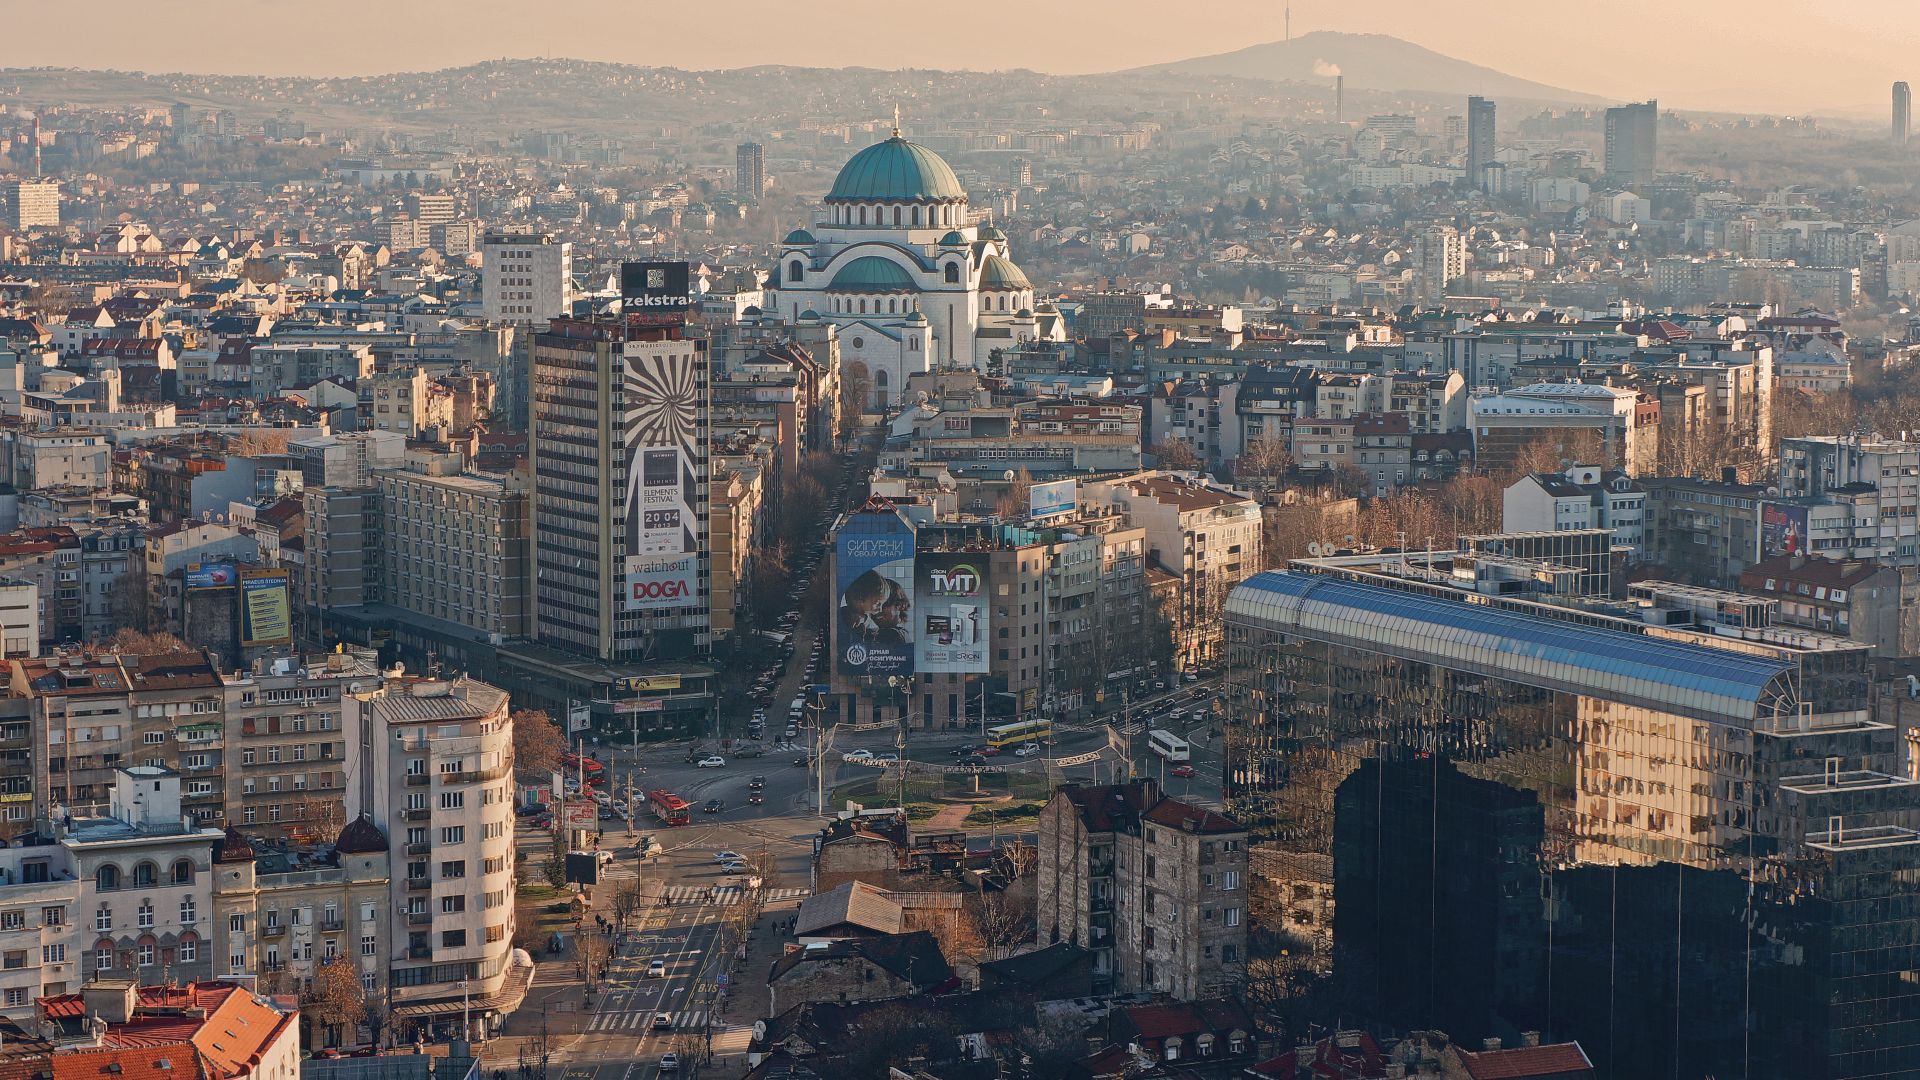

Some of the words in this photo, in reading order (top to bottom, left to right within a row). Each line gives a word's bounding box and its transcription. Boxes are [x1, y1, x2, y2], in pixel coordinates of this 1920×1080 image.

[624, 294, 687, 306] zekstra
[644, 489, 678, 497] ELEMENTS
[644, 496, 674, 504] FESTIVAL
[847, 540, 904, 551] СИГУРНИ
[633, 559, 689, 574] watchout
[646, 918, 667, 927] BUS
